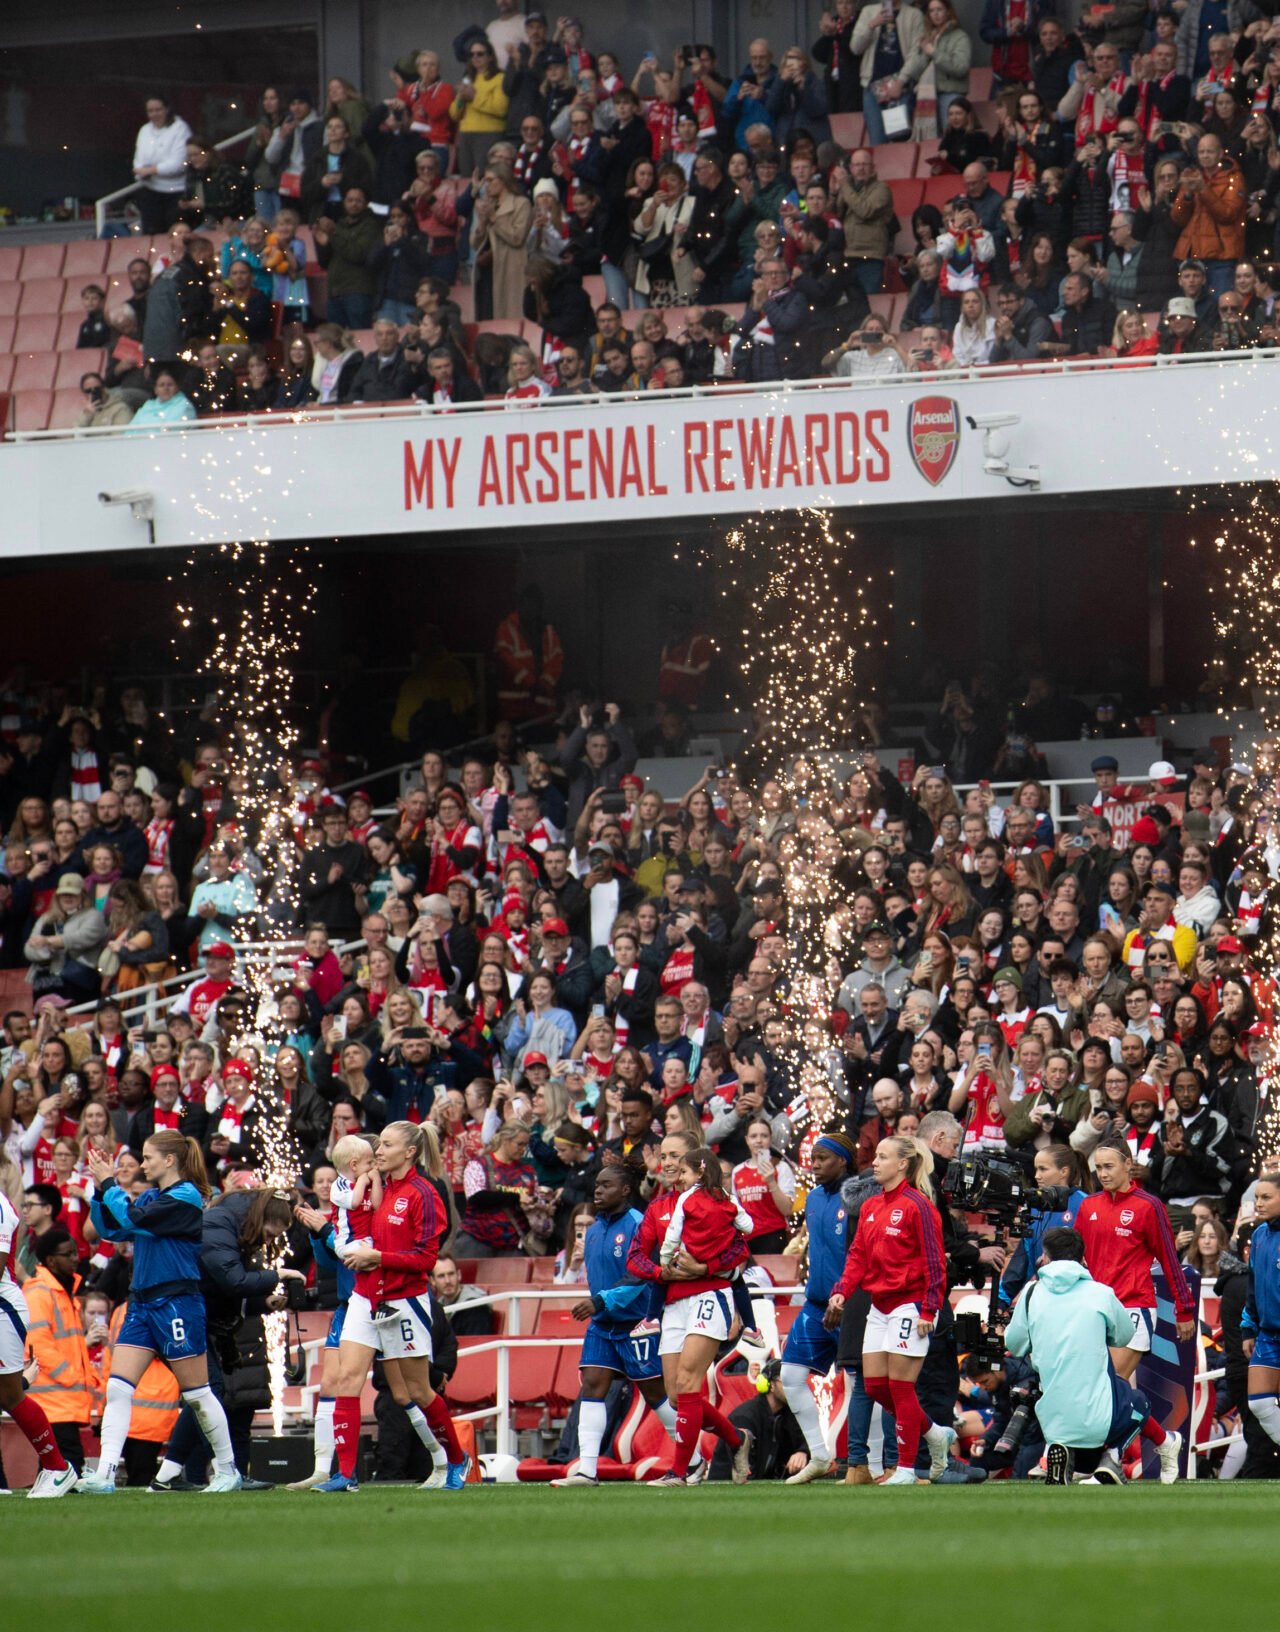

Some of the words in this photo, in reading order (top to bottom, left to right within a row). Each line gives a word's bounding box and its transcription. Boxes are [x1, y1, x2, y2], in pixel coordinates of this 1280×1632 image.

[913, 408, 953, 425] Arsenal
[403, 436, 462, 511] MY
[477, 424, 668, 507] ARSENAL
[684, 408, 891, 494] REWARDS
[697, 1299, 715, 1321] 13
[171, 1317, 185, 1341] 6
[399, 1318, 414, 1342] 6
[899, 1317, 912, 1340] 9
[631, 1338, 650, 1361] 17
